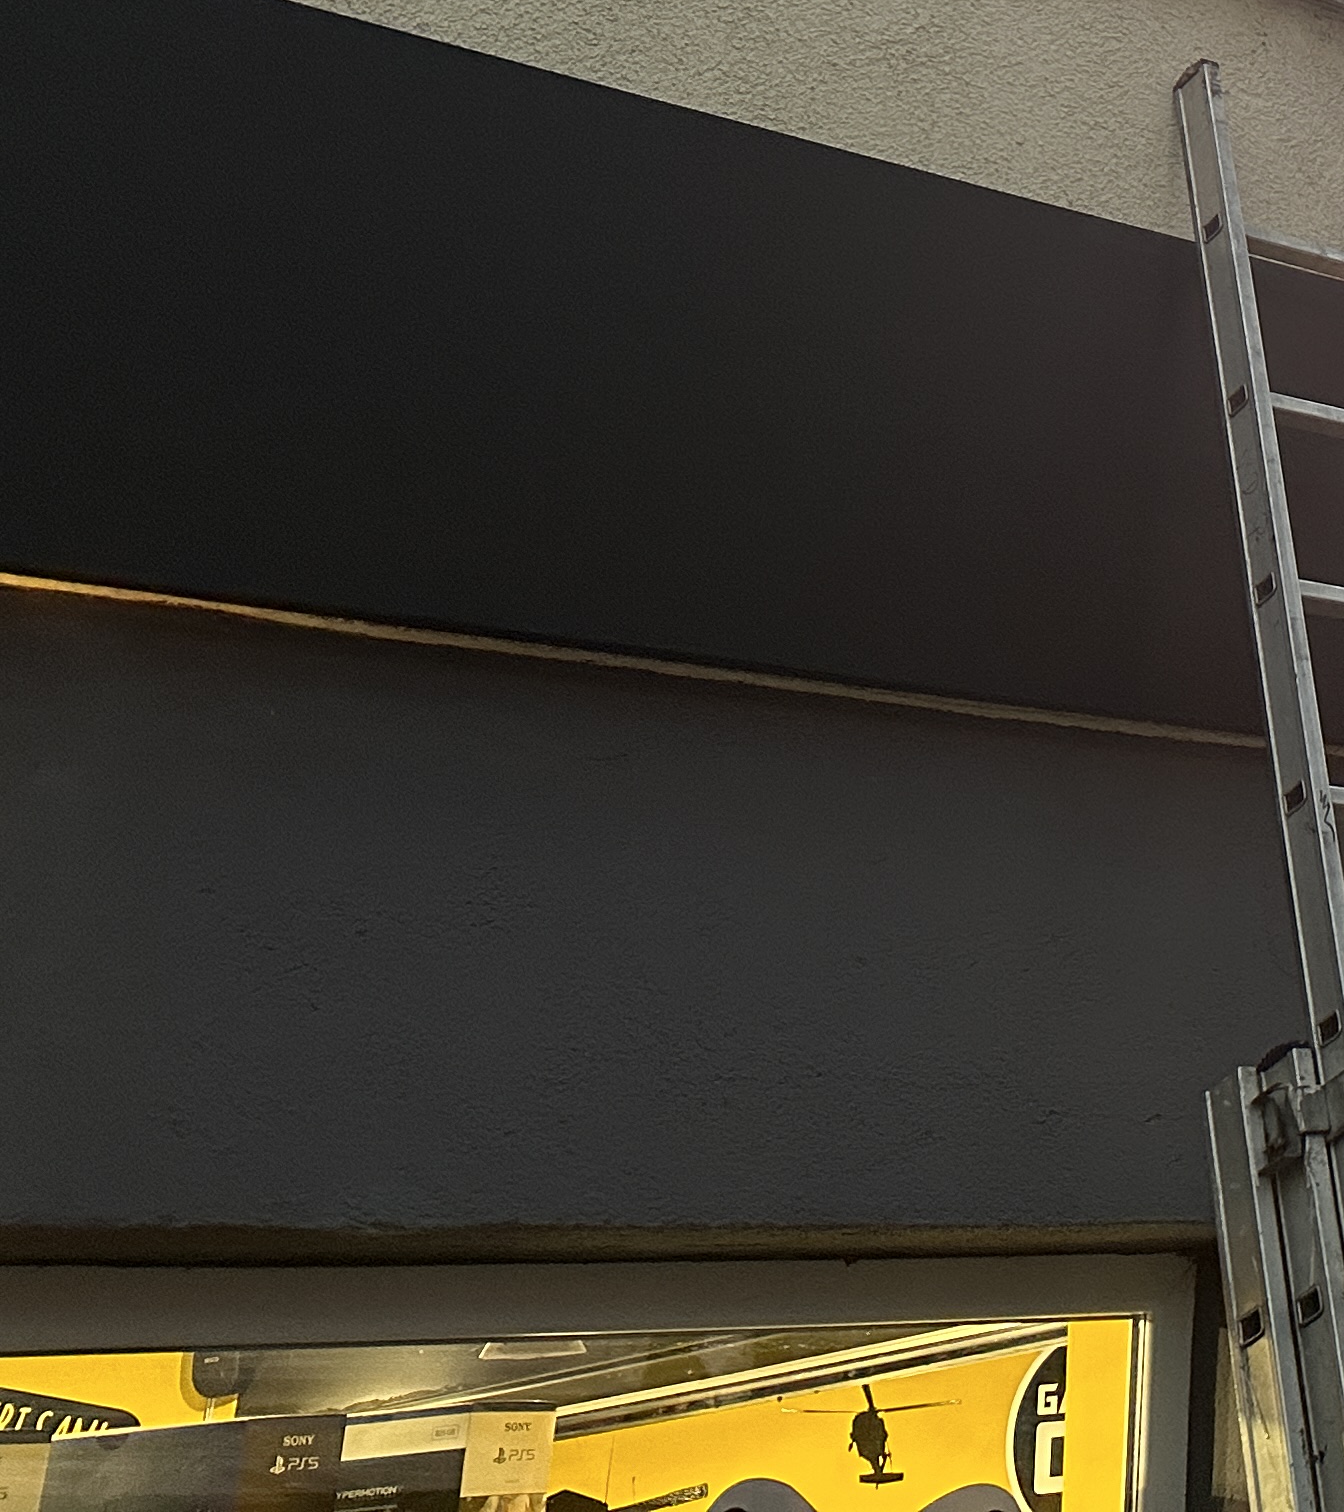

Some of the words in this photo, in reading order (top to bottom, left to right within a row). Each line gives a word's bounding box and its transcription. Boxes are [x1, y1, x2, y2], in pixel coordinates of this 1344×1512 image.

[1036, 1382, 1067, 1416] G
[504, 1422, 532, 1432] SONY
[282, 1434, 316, 1447] SONY
[508, 1448, 536, 1462] PS5
[287, 1456, 320, 1471] PS5
